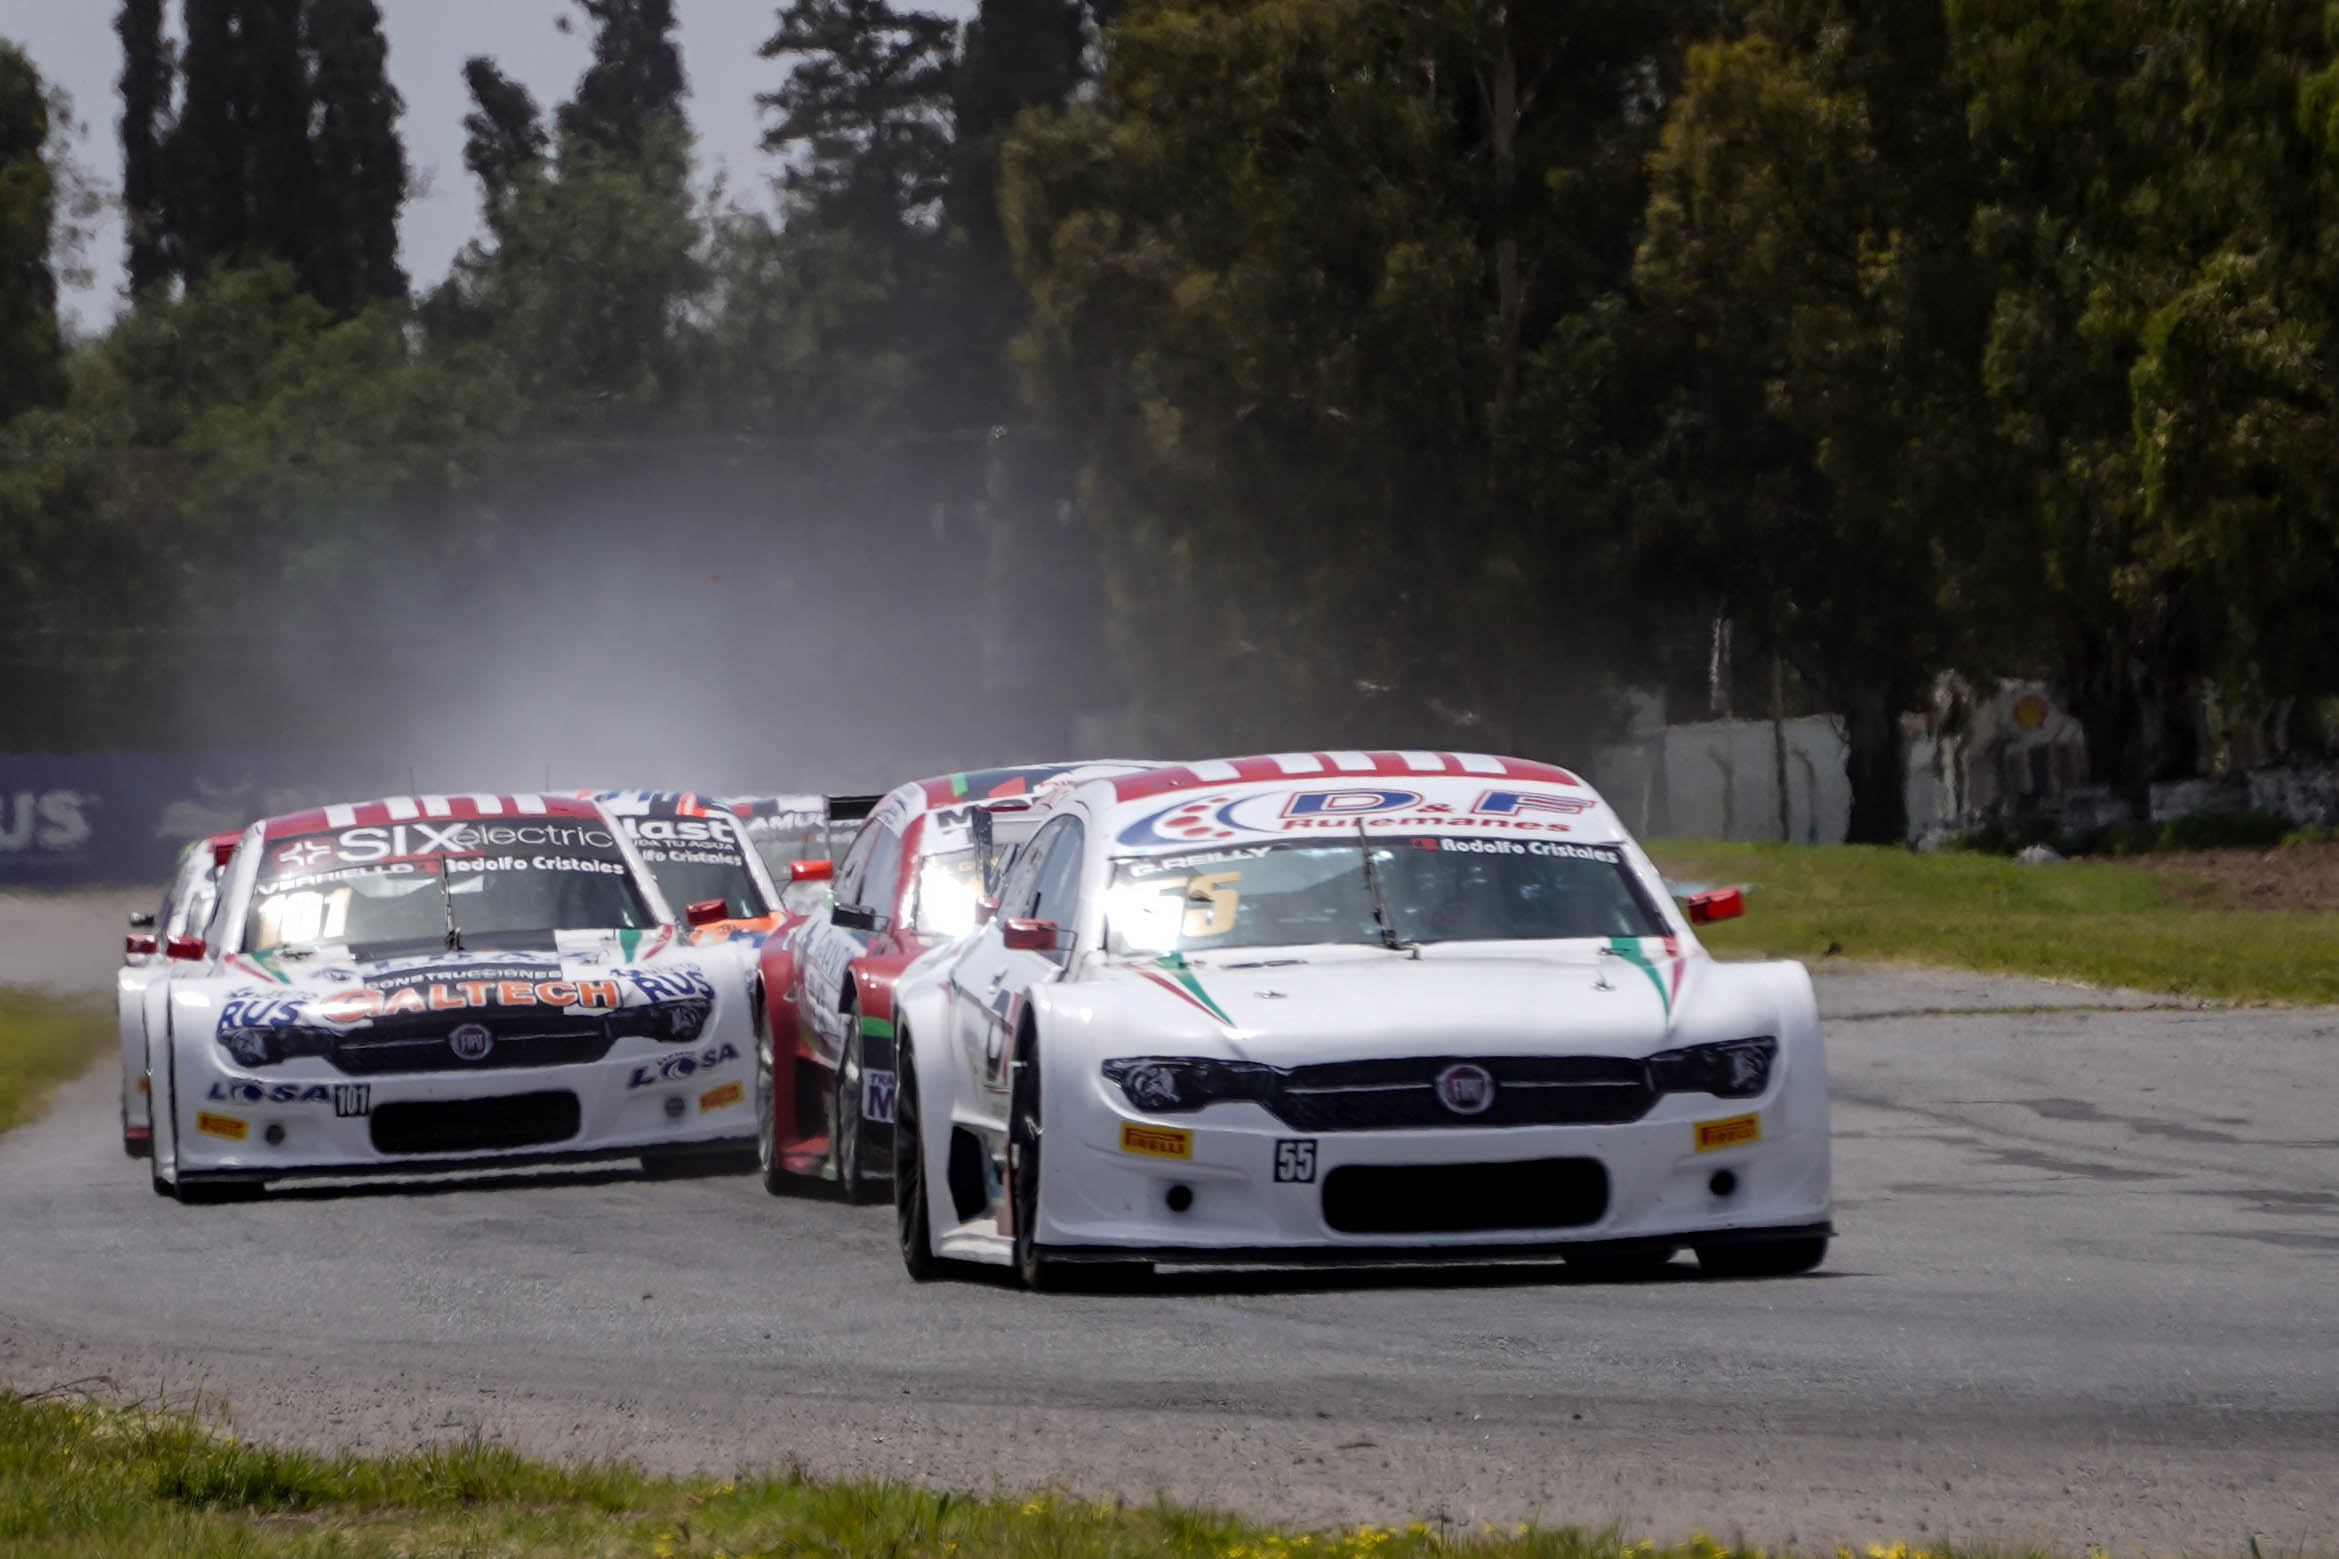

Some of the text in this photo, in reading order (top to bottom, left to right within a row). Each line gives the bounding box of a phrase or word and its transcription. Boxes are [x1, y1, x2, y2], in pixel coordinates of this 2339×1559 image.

[1278, 788, 1597, 818] D & F
[1281, 815, 1572, 833] Rulemanes
[445, 855, 625, 875] Rodolfo Cristales
[1440, 838, 1620, 864] Rodolfo Cristales
[366, 968, 563, 990] CONSTRUCCIONES
[631, 970, 715, 1003] RUS
[216, 1000, 305, 1034] RUS
[335, 1084, 369, 1117] 101
[1125, 1126, 1186, 1154] PIRELLI
[1277, 1141, 1314, 1181] 55
